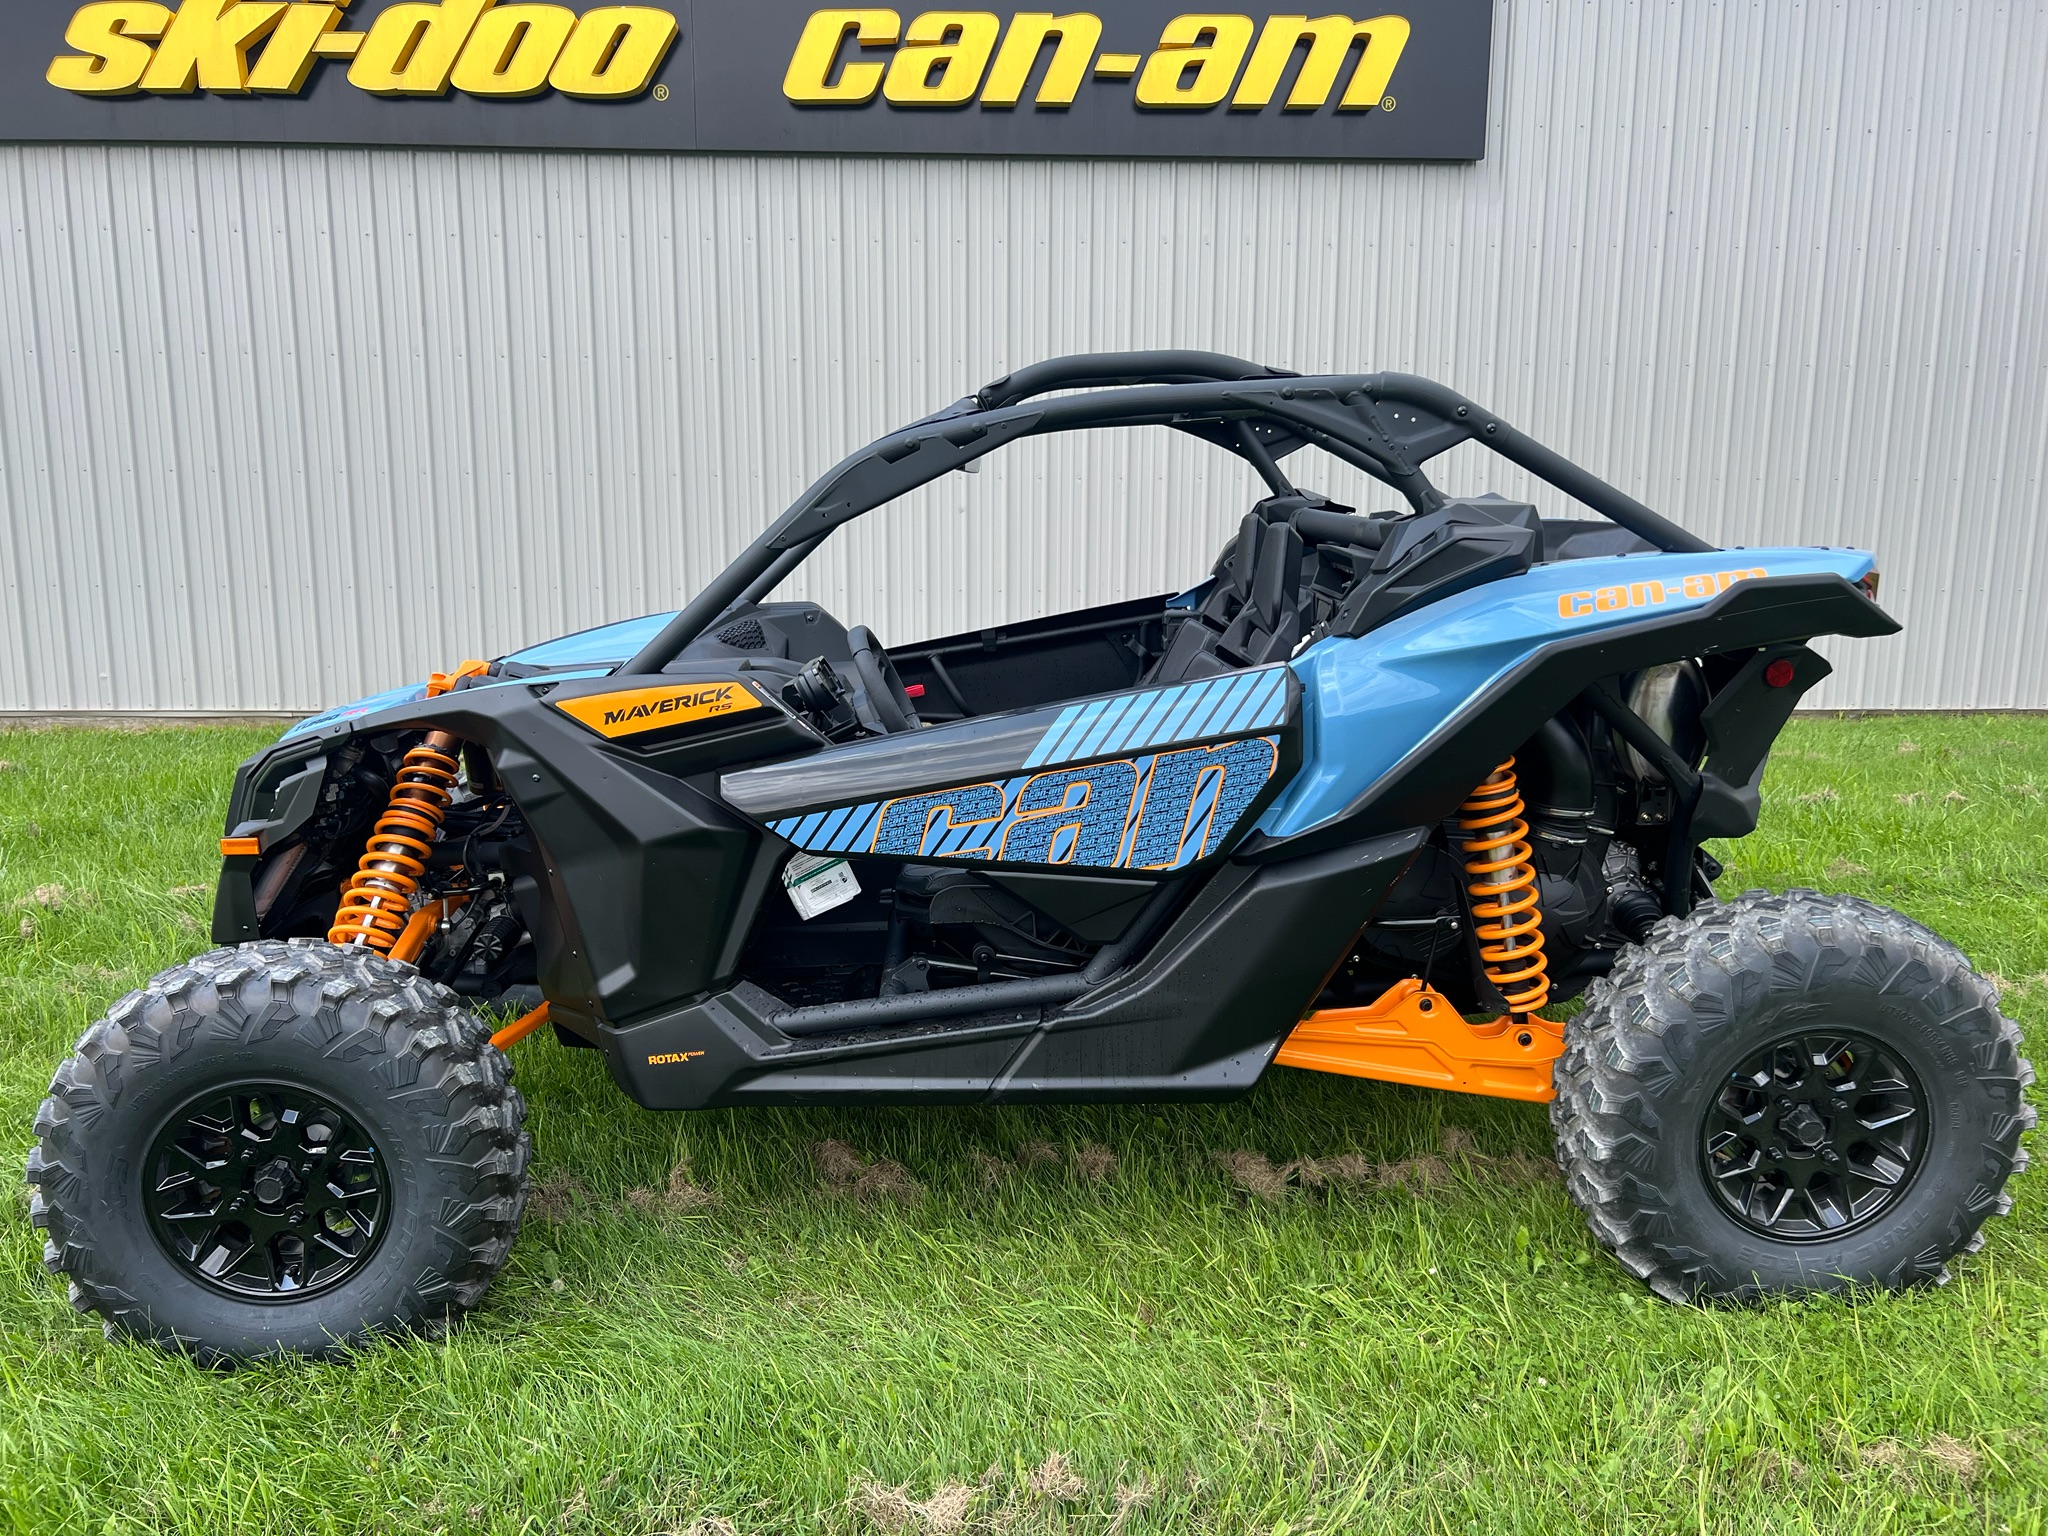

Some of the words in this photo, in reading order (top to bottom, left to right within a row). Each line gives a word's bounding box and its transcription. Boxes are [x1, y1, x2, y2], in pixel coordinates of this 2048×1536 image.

[46, 0, 680, 98] ski-doo
[783, 8, 1411, 113] can-am
[294, 713, 341, 732] TURBO
[604, 685, 734, 725] MAVERICK
[708, 702, 732, 713] RS
[870, 736, 1278, 870] can
[647, 1052, 689, 1065] ROTAX
